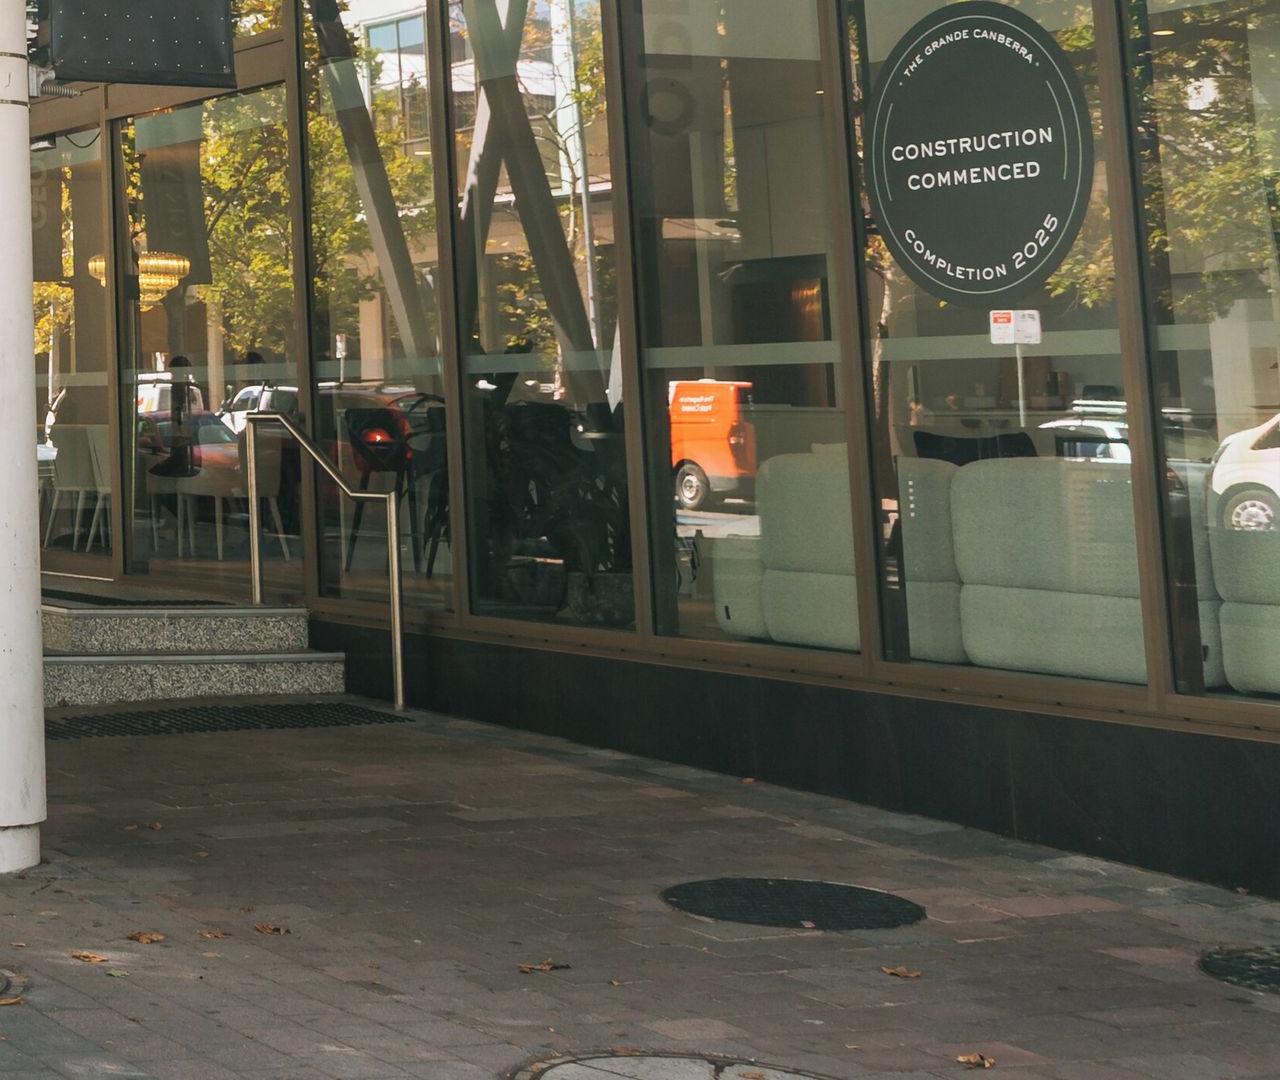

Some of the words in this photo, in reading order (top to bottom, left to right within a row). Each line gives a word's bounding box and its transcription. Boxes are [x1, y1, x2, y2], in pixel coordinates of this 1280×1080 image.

[903, 54, 924, 78] THE
[924, 29, 969, 56] GRANDE
[973, 28, 1035, 65] CANBERRA
[891, 126, 1054, 163] CONSTRUCTION
[907, 161, 1041, 191] COMMENCED
[904, 228, 1007, 281] COMPLETION
[1012, 213, 1059, 270] 2025
